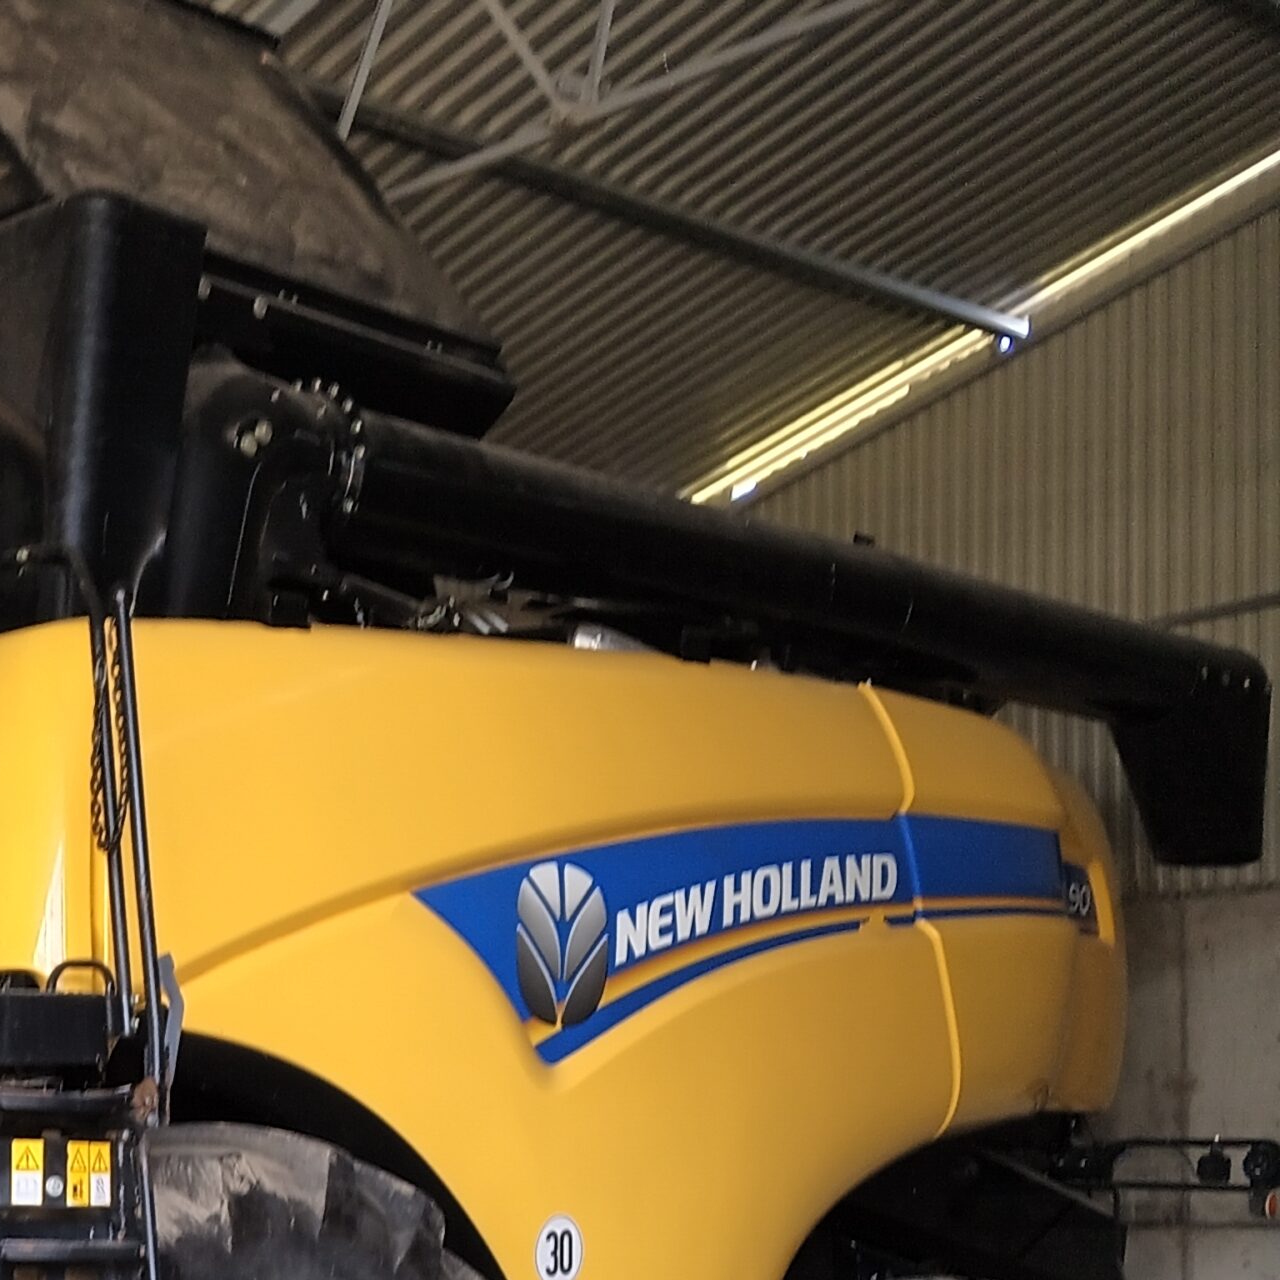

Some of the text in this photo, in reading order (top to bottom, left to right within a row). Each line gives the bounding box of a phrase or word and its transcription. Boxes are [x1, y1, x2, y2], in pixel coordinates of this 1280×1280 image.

[615, 853, 898, 967] NEW HOLLAND
[545, 1229, 574, 1277] 30
